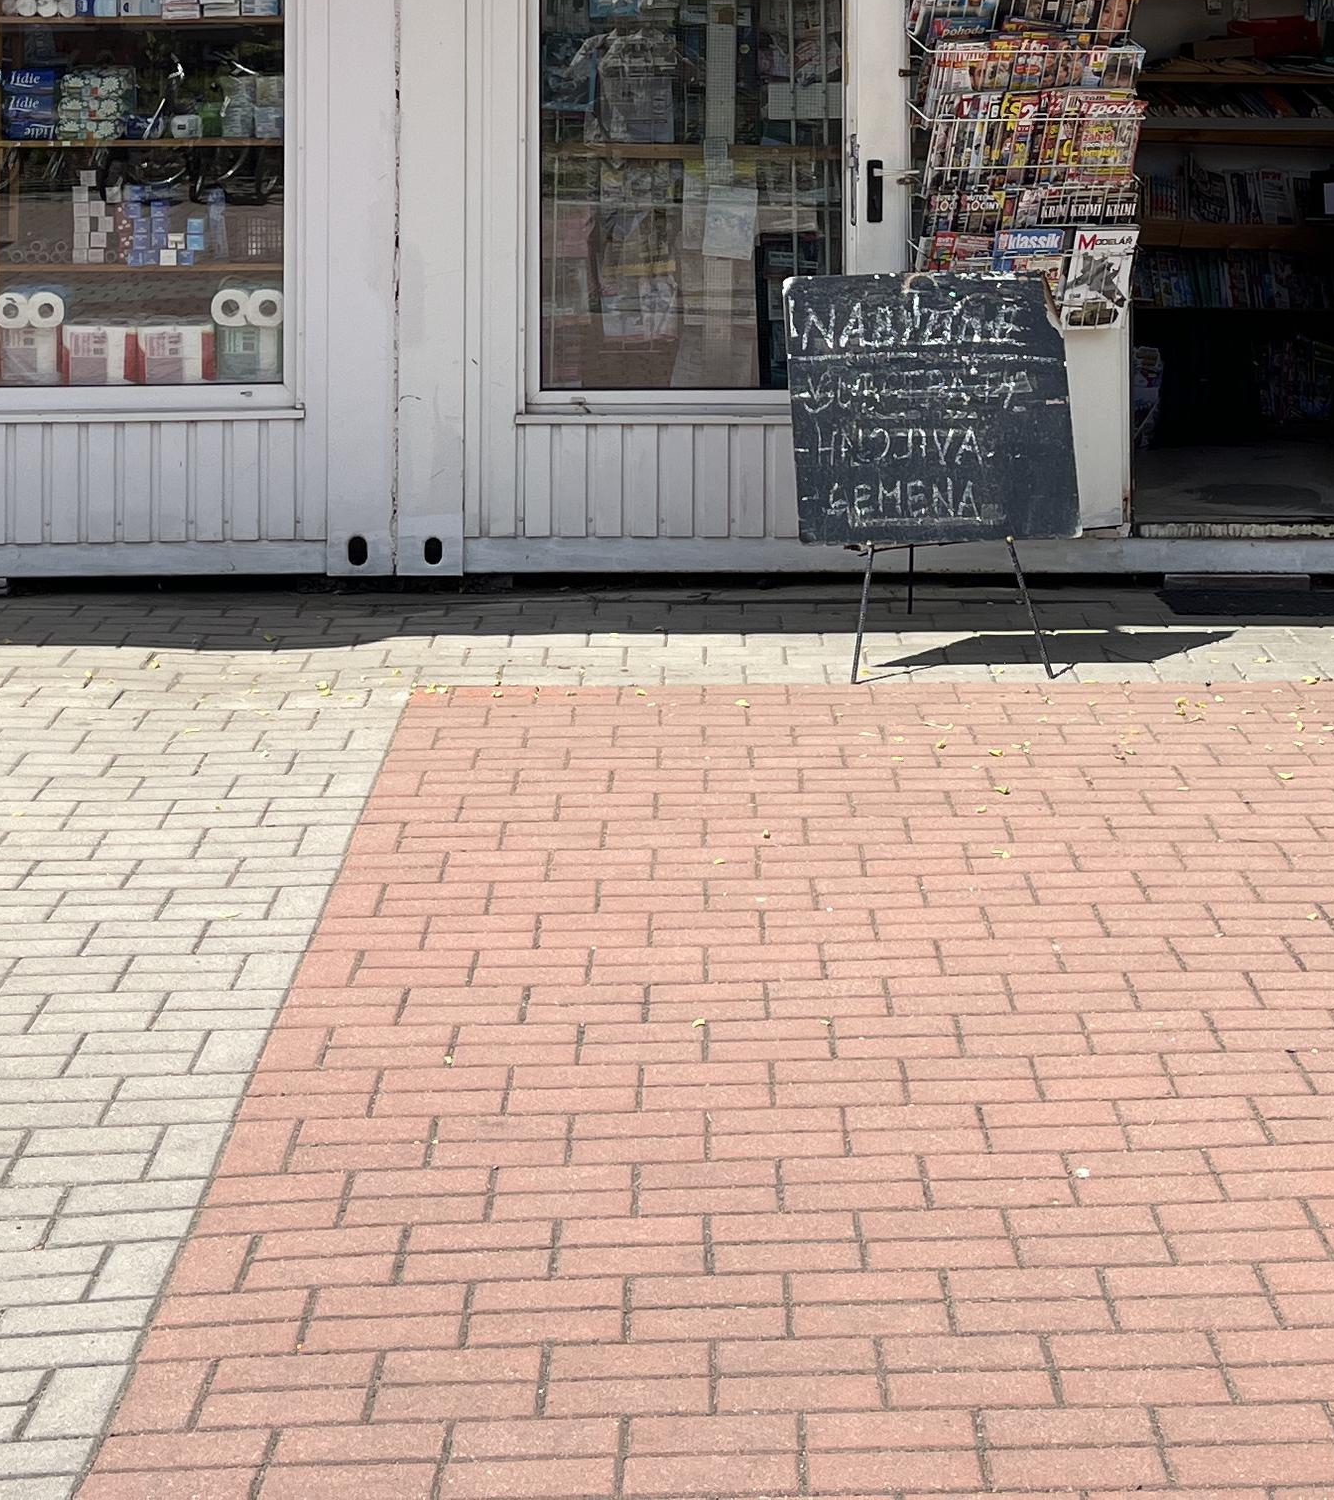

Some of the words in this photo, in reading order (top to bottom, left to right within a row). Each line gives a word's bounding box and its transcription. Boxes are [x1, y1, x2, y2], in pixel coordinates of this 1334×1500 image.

[942, 25, 986, 38] pohoda
[9, 71, 41, 87] Lidie
[8, 97, 41, 112] Lidie
[1070, 203, 1103, 217] KRIMI
[1106, 202, 1137, 217] KRIMI
[1008, 233, 1061, 250] klassik
[824, 476, 982, 523] SEMENA
